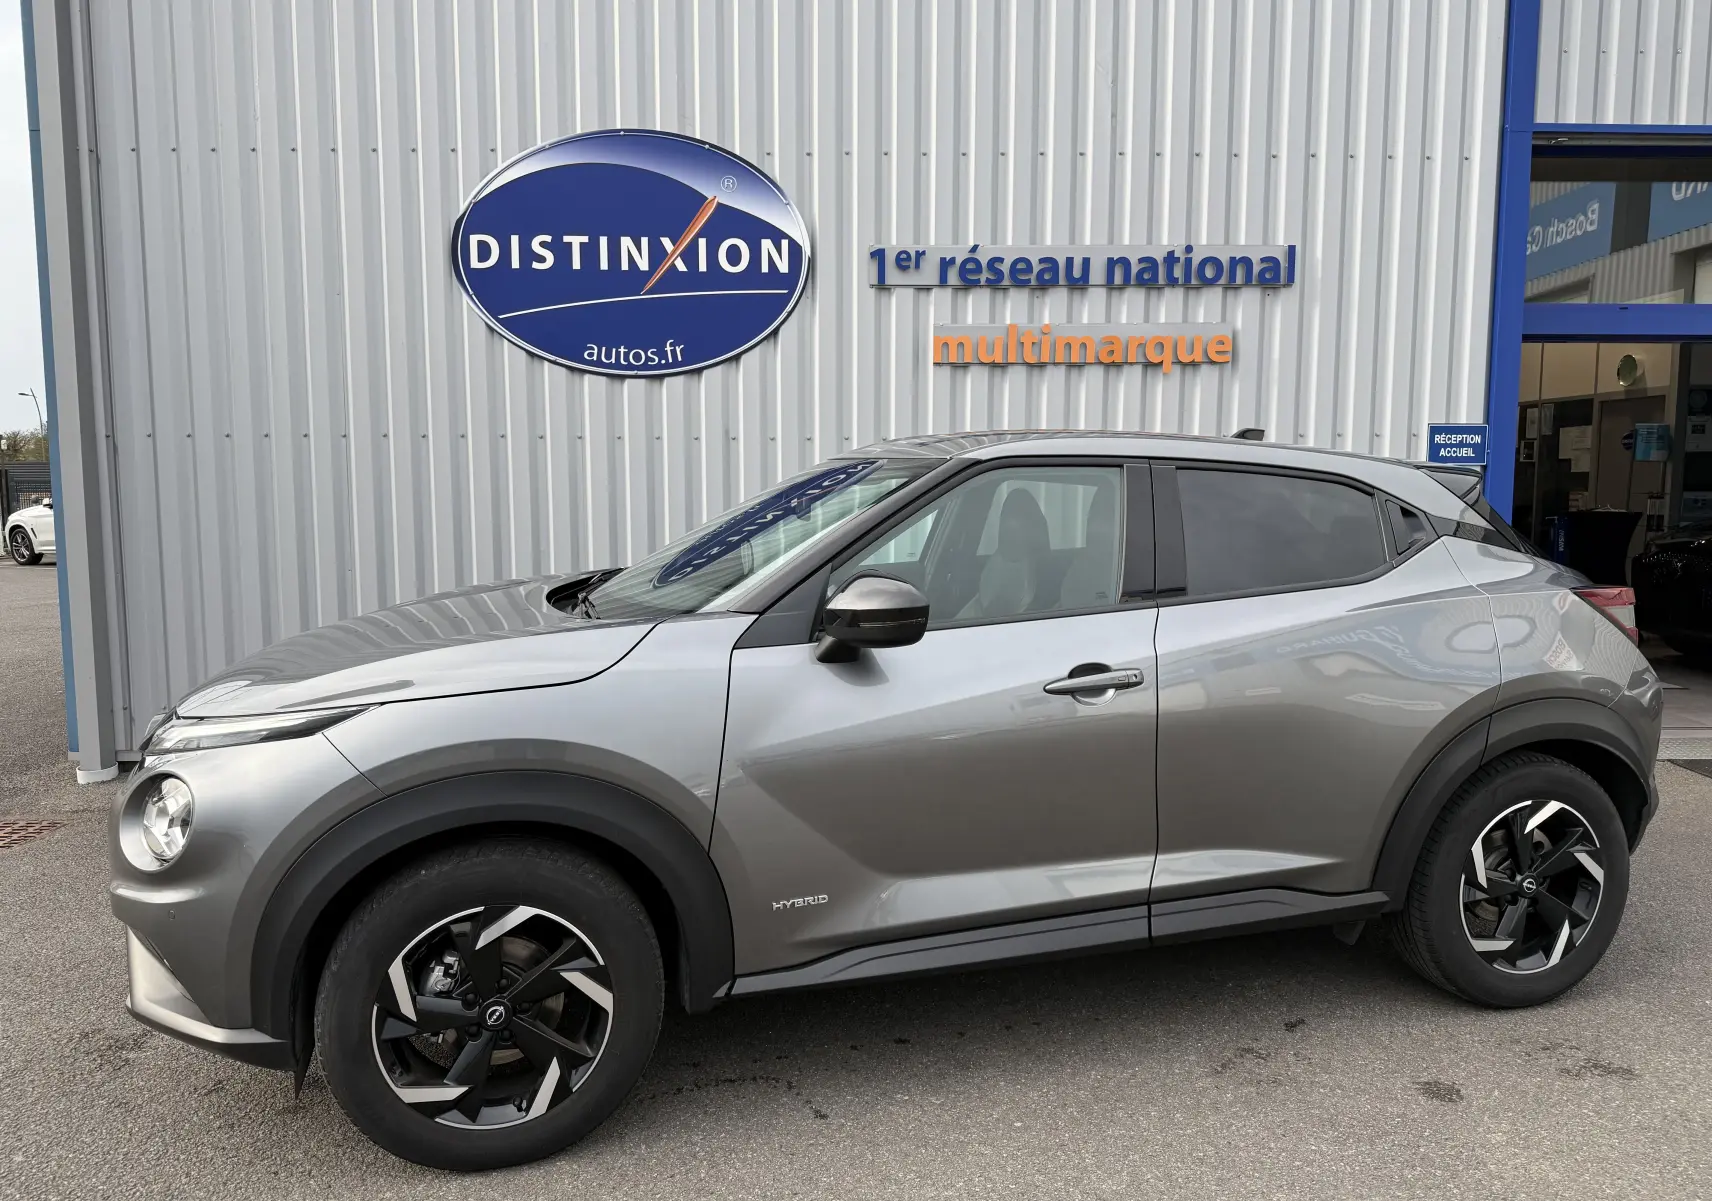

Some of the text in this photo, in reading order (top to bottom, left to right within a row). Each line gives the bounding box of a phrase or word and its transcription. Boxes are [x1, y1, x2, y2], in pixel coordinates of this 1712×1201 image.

[468, 233, 789, 274] DISTINXION
[869, 243, 1297, 286] 1er réseau national
[583, 339, 685, 366] autos.fr
[933, 323, 1232, 373] multimarque
[1434, 432, 1482, 444] RÉCEPTION
[1439, 447, 1476, 457] ACCUEIL
[771, 894, 829, 911] HYBRID
